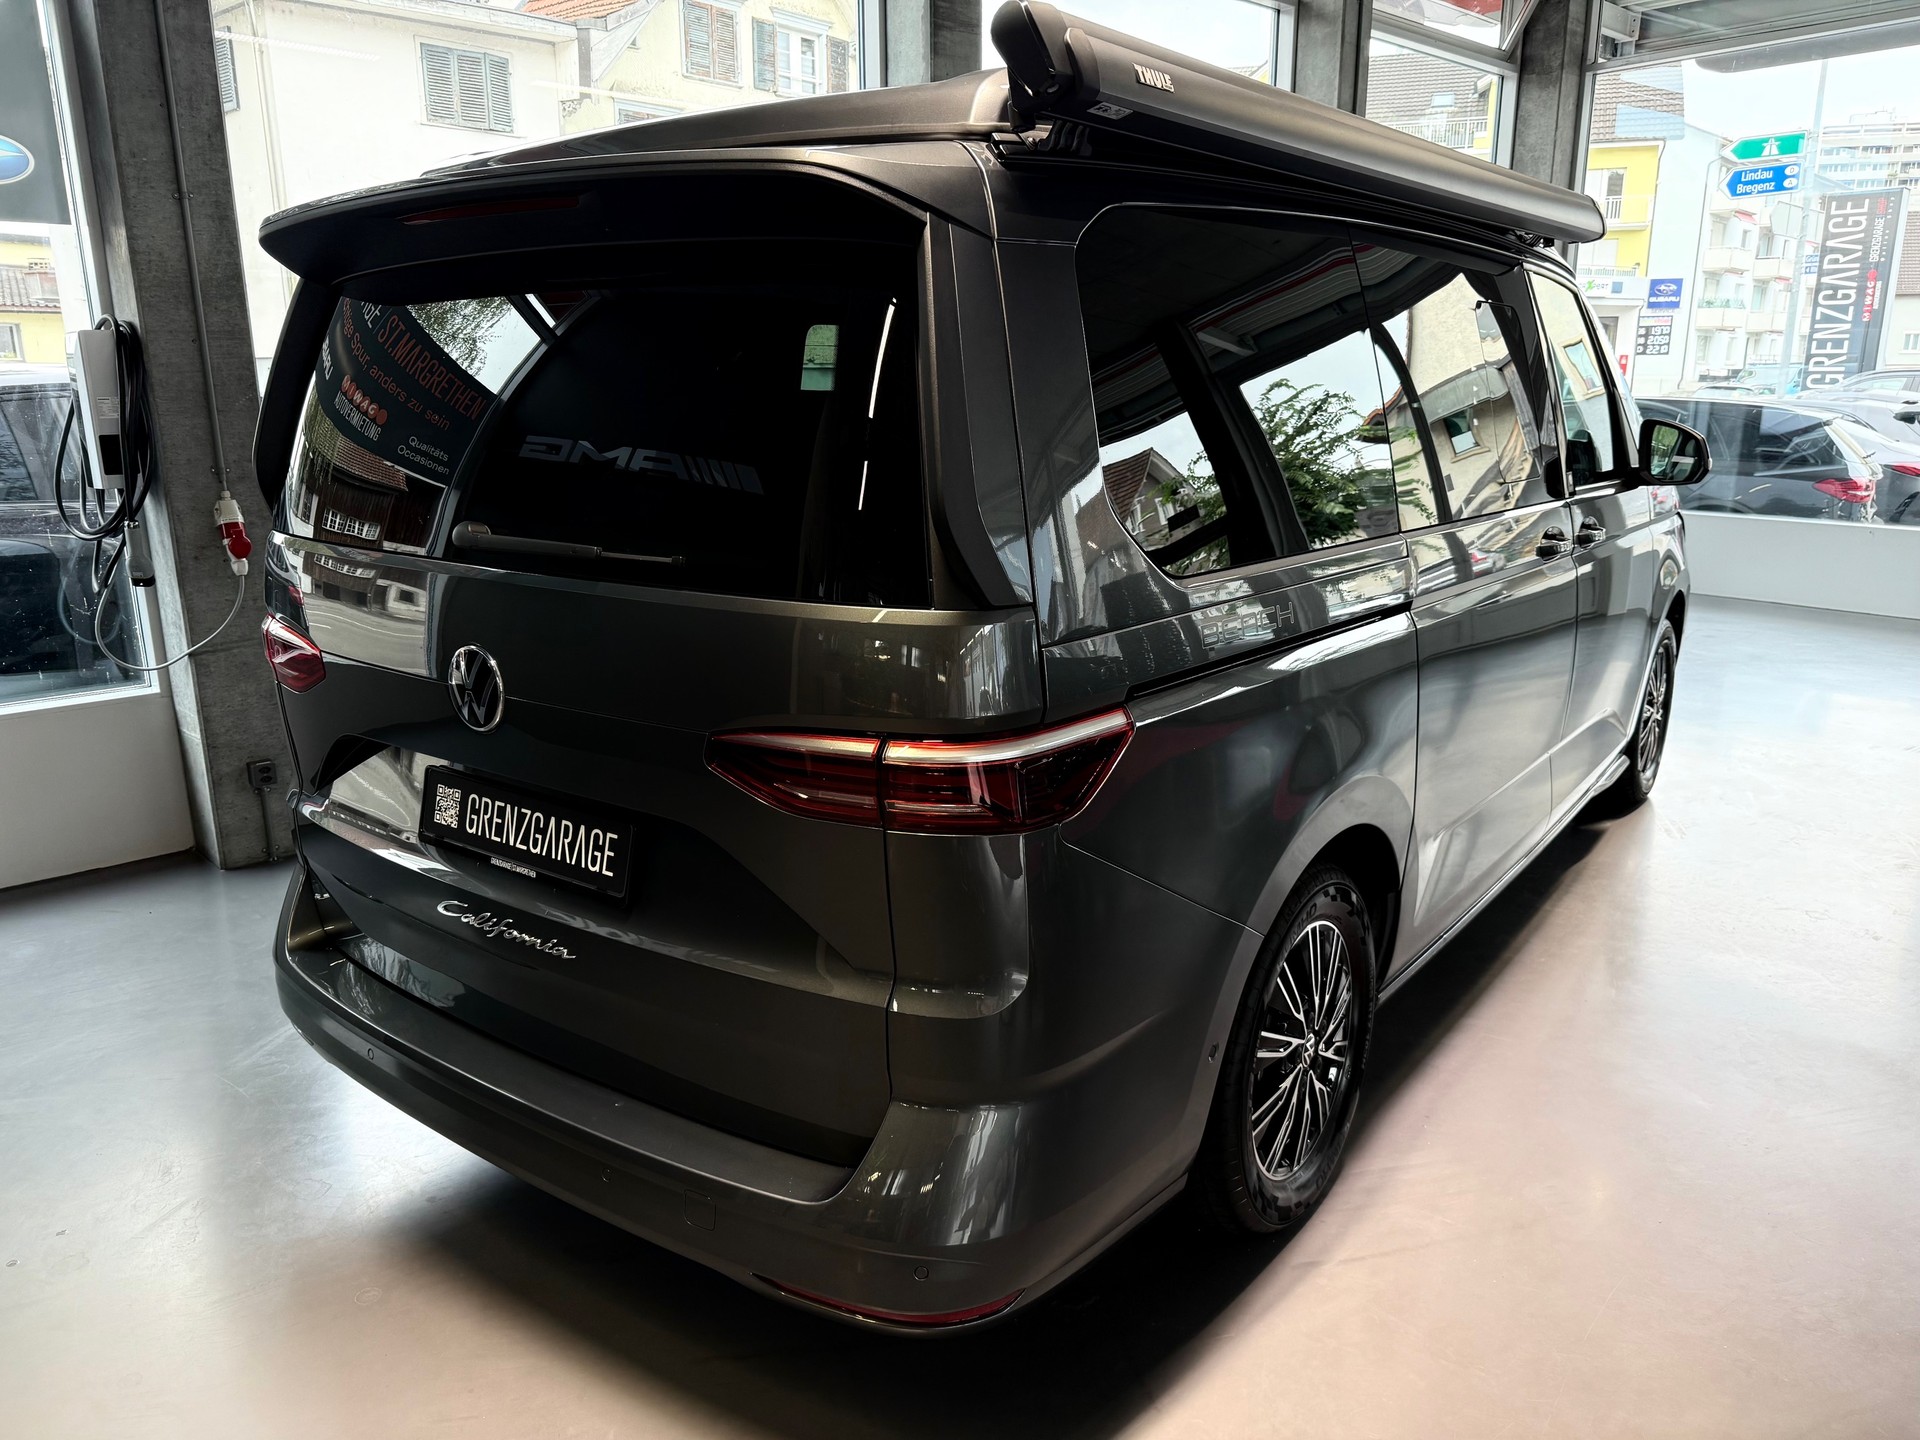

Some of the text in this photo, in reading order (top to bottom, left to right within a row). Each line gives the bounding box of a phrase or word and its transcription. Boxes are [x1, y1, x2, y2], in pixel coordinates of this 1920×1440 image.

[1132, 62, 1175, 94] THULE
[1736, 181, 1776, 194] Bregenz
[1741, 169, 1773, 181] Lindau
[1806, 198, 1870, 389] GRENZGARAGE
[351, 333, 371, 371] Spur,
[369, 365, 408, 402] anders
[407, 398, 424, 413] zu
[424, 409, 450, 431] sein
[377, 314, 487, 421] ST.MARGRETHEN
[333, 390, 382, 441] AUTOVERMIETUNG
[397, 444, 450, 475] Occasionen
[408, 436, 449, 461] Qualitäts
[465, 792, 620, 878] GRENZGARAGE
[436, 899, 577, 960] California
